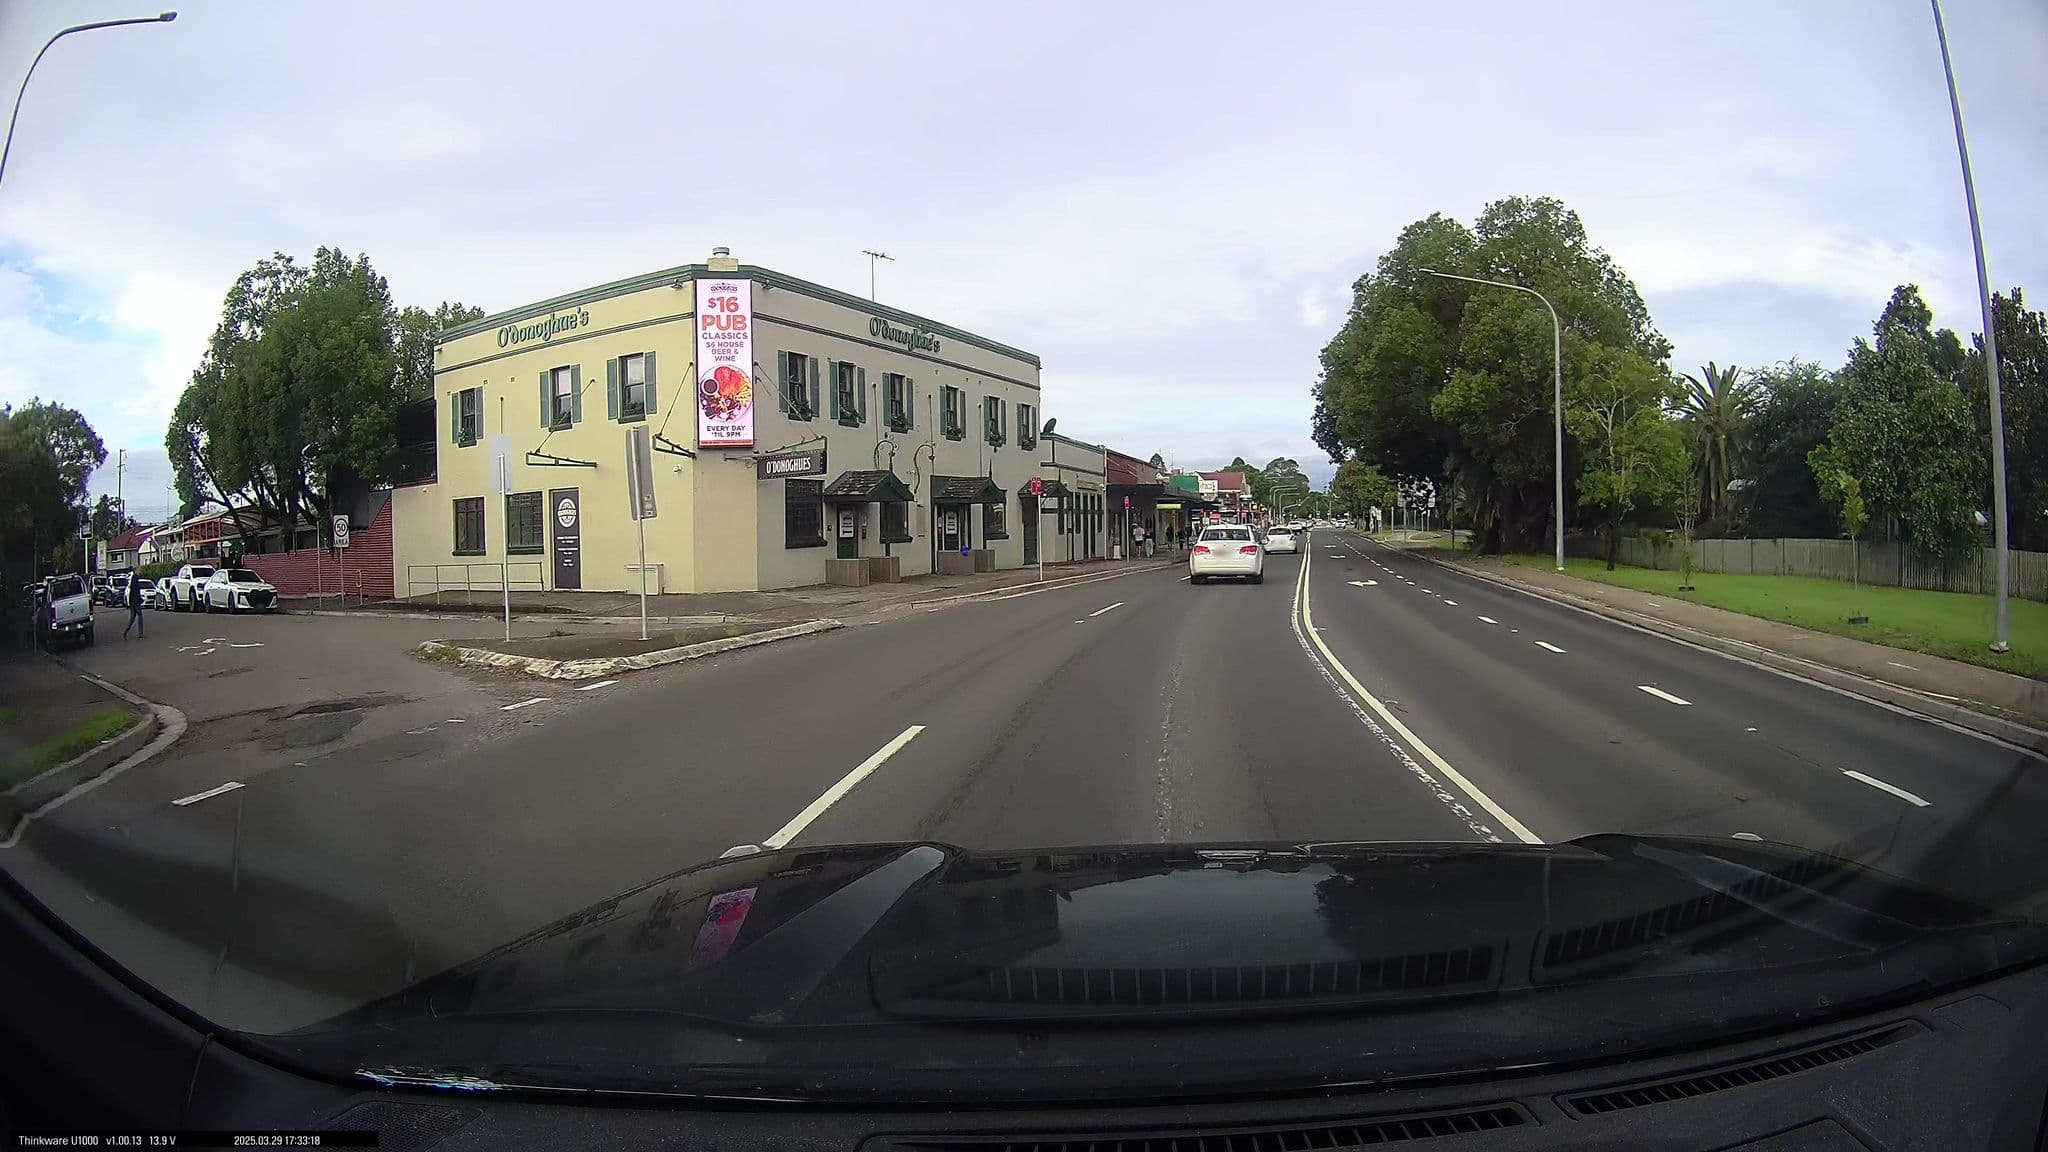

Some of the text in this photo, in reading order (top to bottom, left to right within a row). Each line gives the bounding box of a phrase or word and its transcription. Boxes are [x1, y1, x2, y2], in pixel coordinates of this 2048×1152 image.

[708, 296, 739, 313] $16
[496, 306, 589, 348] O'Donoghue's
[701, 314, 747, 331] PUB
[702, 332, 748, 340] CLASSICS
[766, 457, 811, 474] O'DONOGHUES
[336, 523, 346, 532] 50
